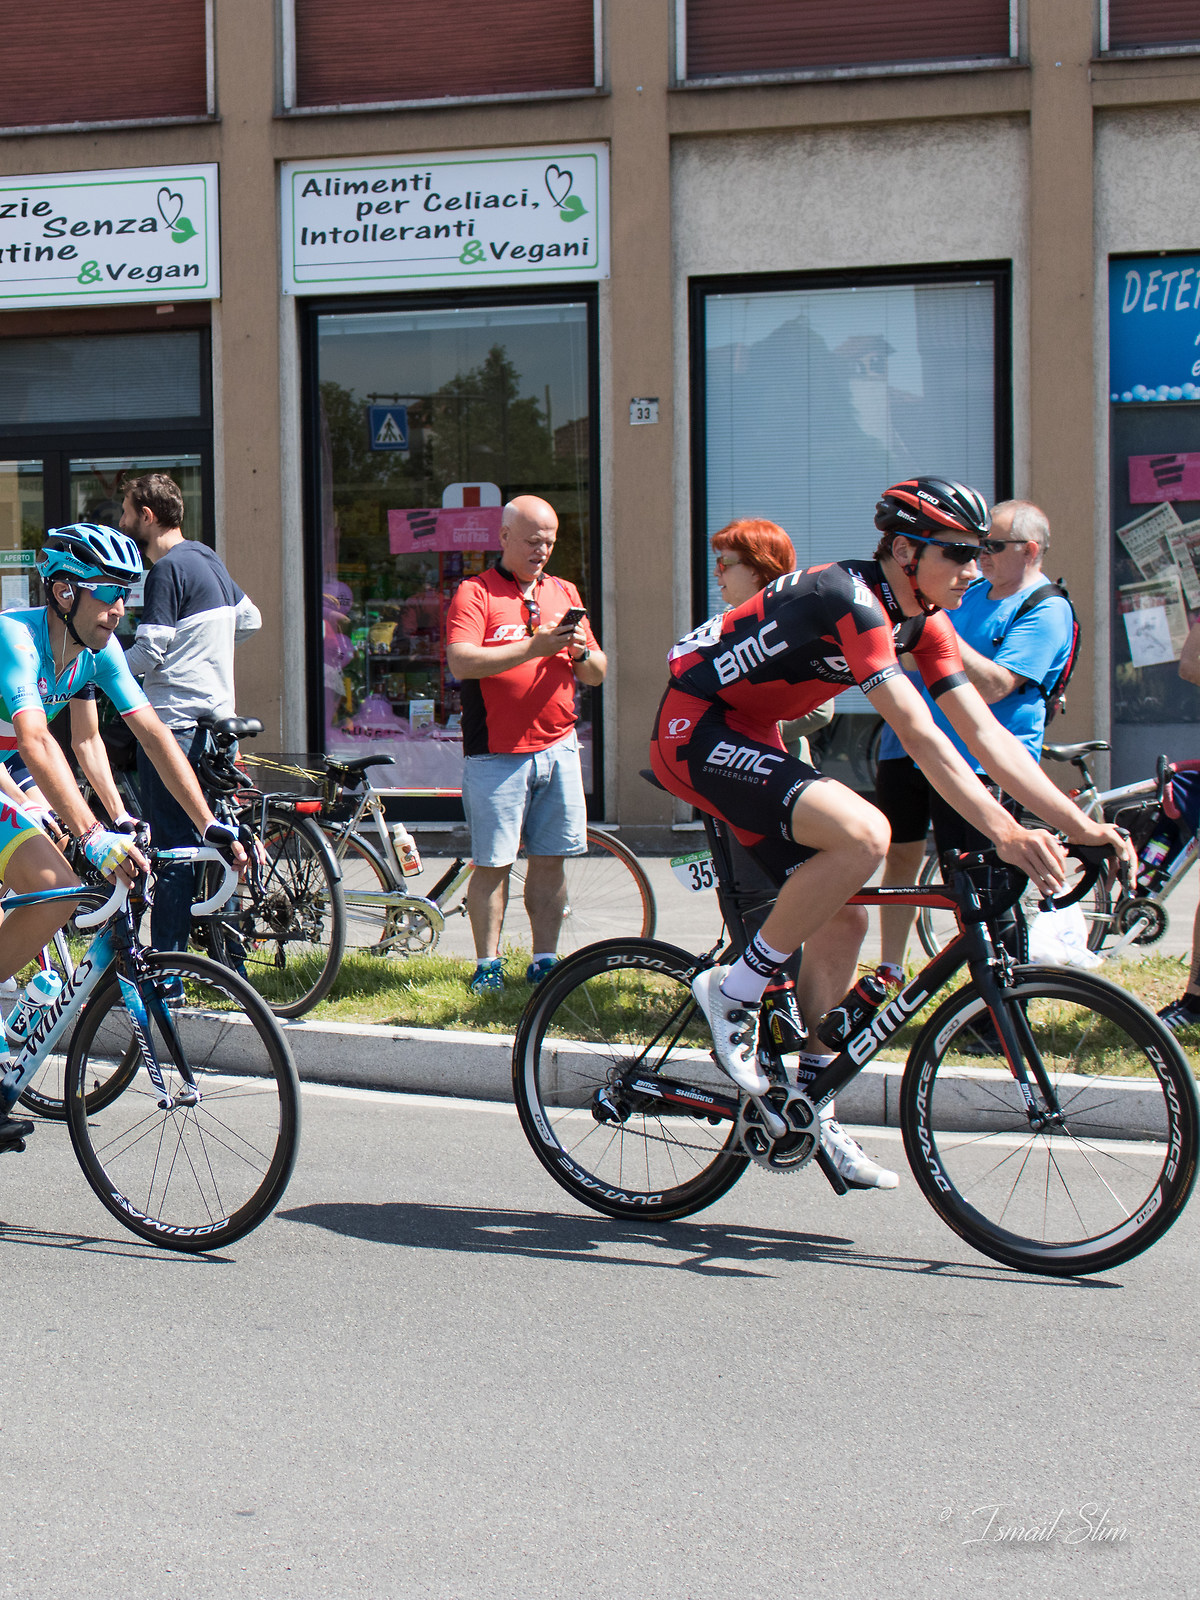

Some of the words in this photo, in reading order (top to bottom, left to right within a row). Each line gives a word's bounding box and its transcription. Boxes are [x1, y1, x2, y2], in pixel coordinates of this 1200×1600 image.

[301, 172, 433, 199] Alimenti
[356, 198, 410, 222] per
[423, 189, 540, 213] Celiaci,
[42, 216, 158, 238] Senza
[301, 218, 476, 246] Intolleranti
[637, 407, 651, 421] 33
[916, 490, 940, 506] GIRO
[896, 509, 917, 524] BMC
[3, 553, 31, 562] APERTO
[881, 582, 898, 611] BMC
[712, 619, 790, 686] BMC
[861, 666, 897, 692] BMC
[705, 740, 786, 776] BMC
[702, 765, 761, 786] SWITZERLAND
[781, 778, 805, 808] BMC
[847, 974, 930, 1067] BMC
[128, 1007, 163, 1086] SPECIALIZED
[635, 1078, 659, 1091] BMC
[674, 1088, 715, 1105] SHIMANO
[1019, 1081, 1035, 1107] BMC
[915, 1060, 952, 1193] DURA-ACE
[1144, 1045, 1182, 1183] DURA-ACE
[557, 1156, 663, 1206] DURA-ACE
[127, 1202, 231, 1237] CORIMA
